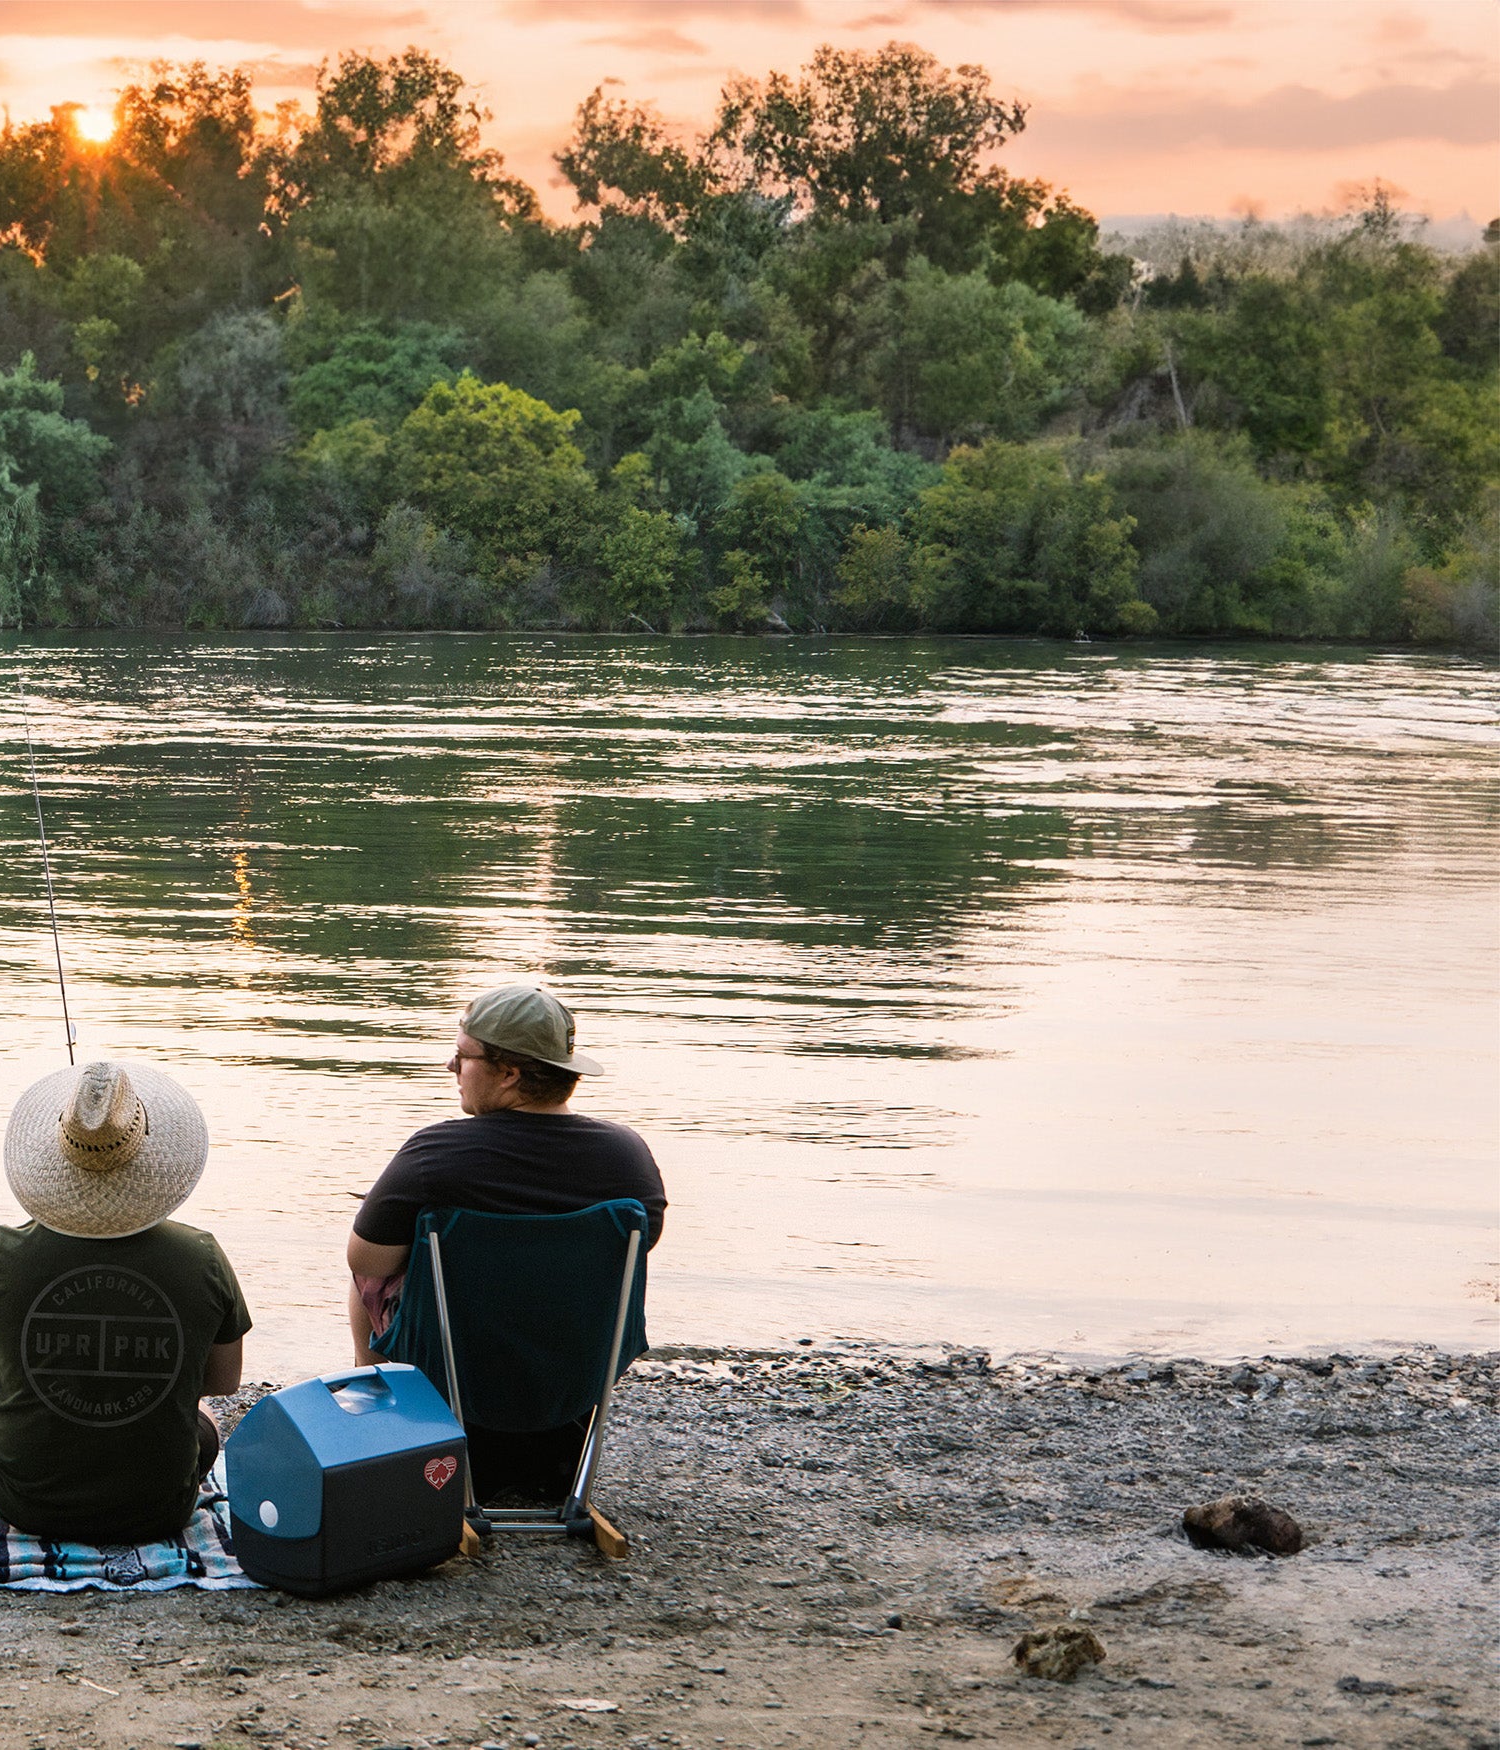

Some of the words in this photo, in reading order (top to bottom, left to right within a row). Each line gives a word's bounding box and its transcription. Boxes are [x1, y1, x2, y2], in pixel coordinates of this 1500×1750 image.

[52, 1275, 156, 1311] CALIFORNIA
[36, 1332, 91, 1356] UPR
[114, 1335, 171, 1360] PRK
